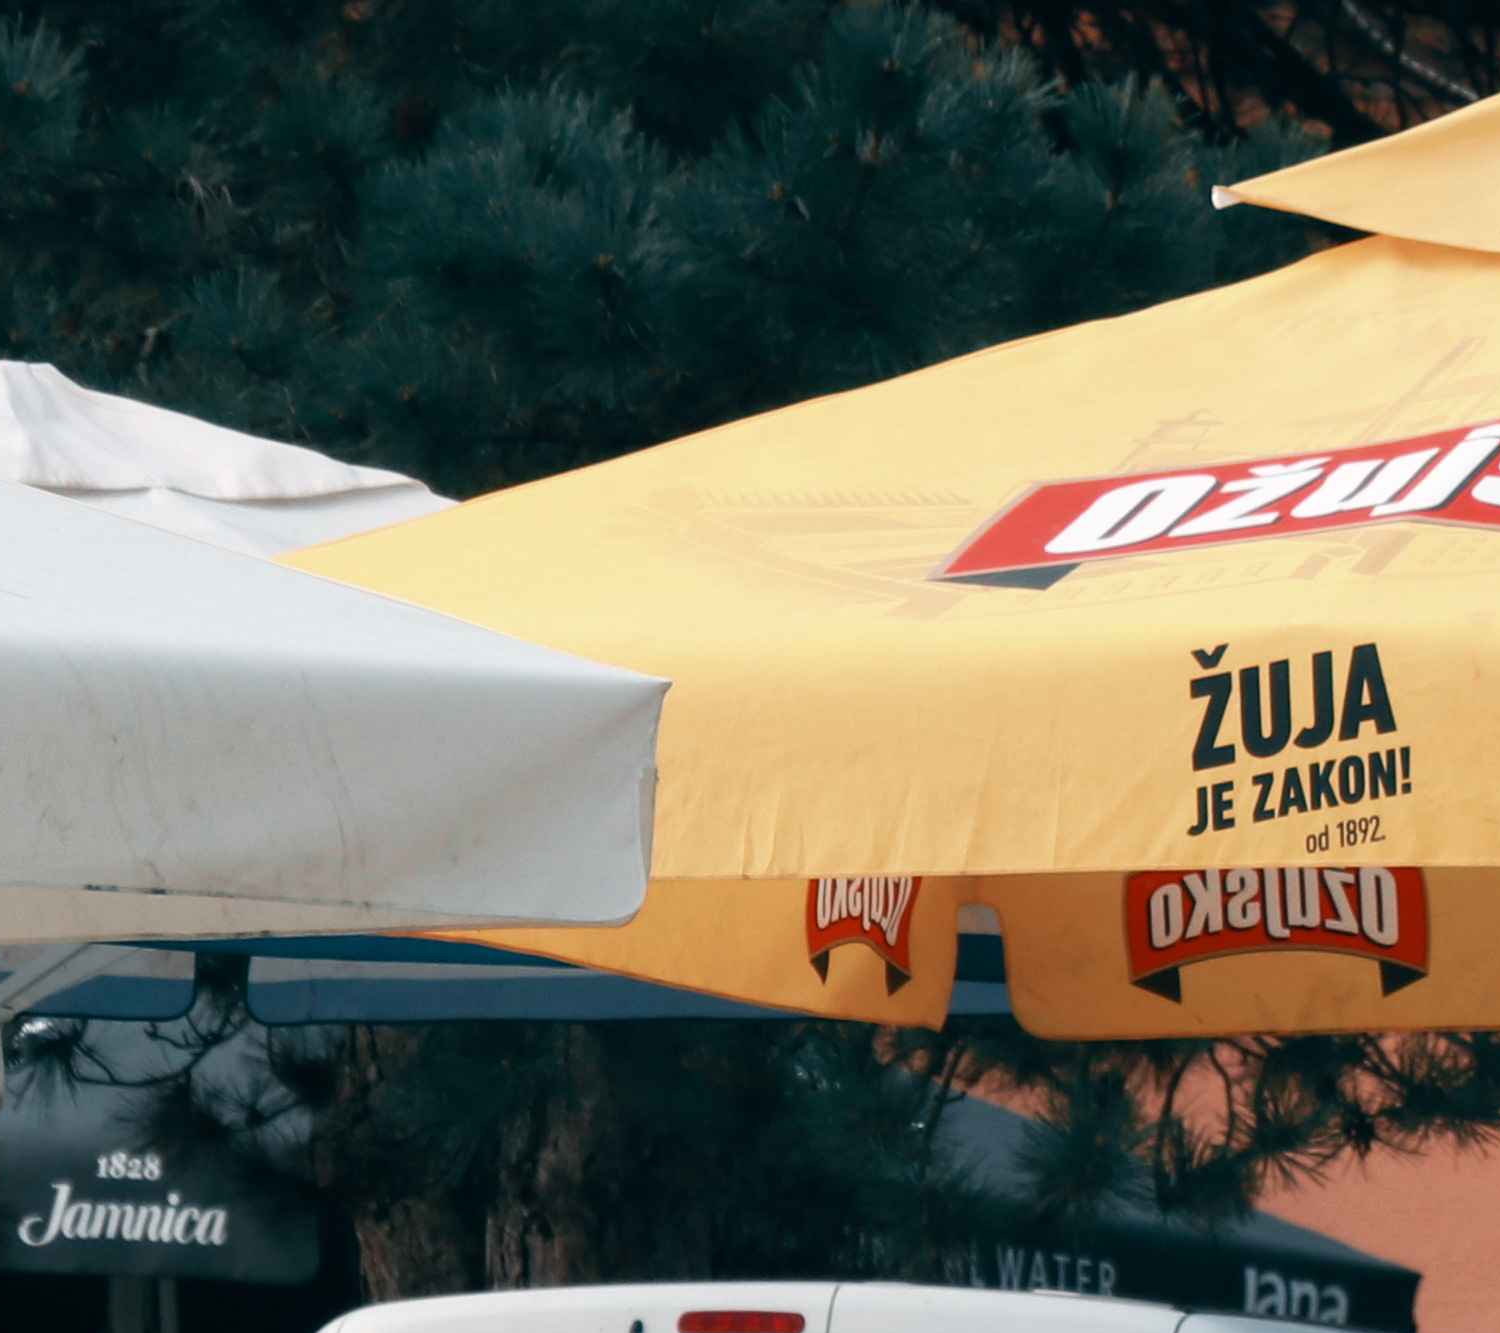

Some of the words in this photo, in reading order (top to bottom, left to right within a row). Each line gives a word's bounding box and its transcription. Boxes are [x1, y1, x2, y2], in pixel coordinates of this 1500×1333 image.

[1190, 642, 1397, 772] ŽUJA
[1186, 780, 1236, 837] JE
[1251, 745, 1413, 824] ZAKON!
[1306, 824, 1330, 854] od
[96, 1152, 162, 1181] 1828
[17, 1182, 228, 1247] Jamnica
[996, 1245, 1118, 1299] WATER
